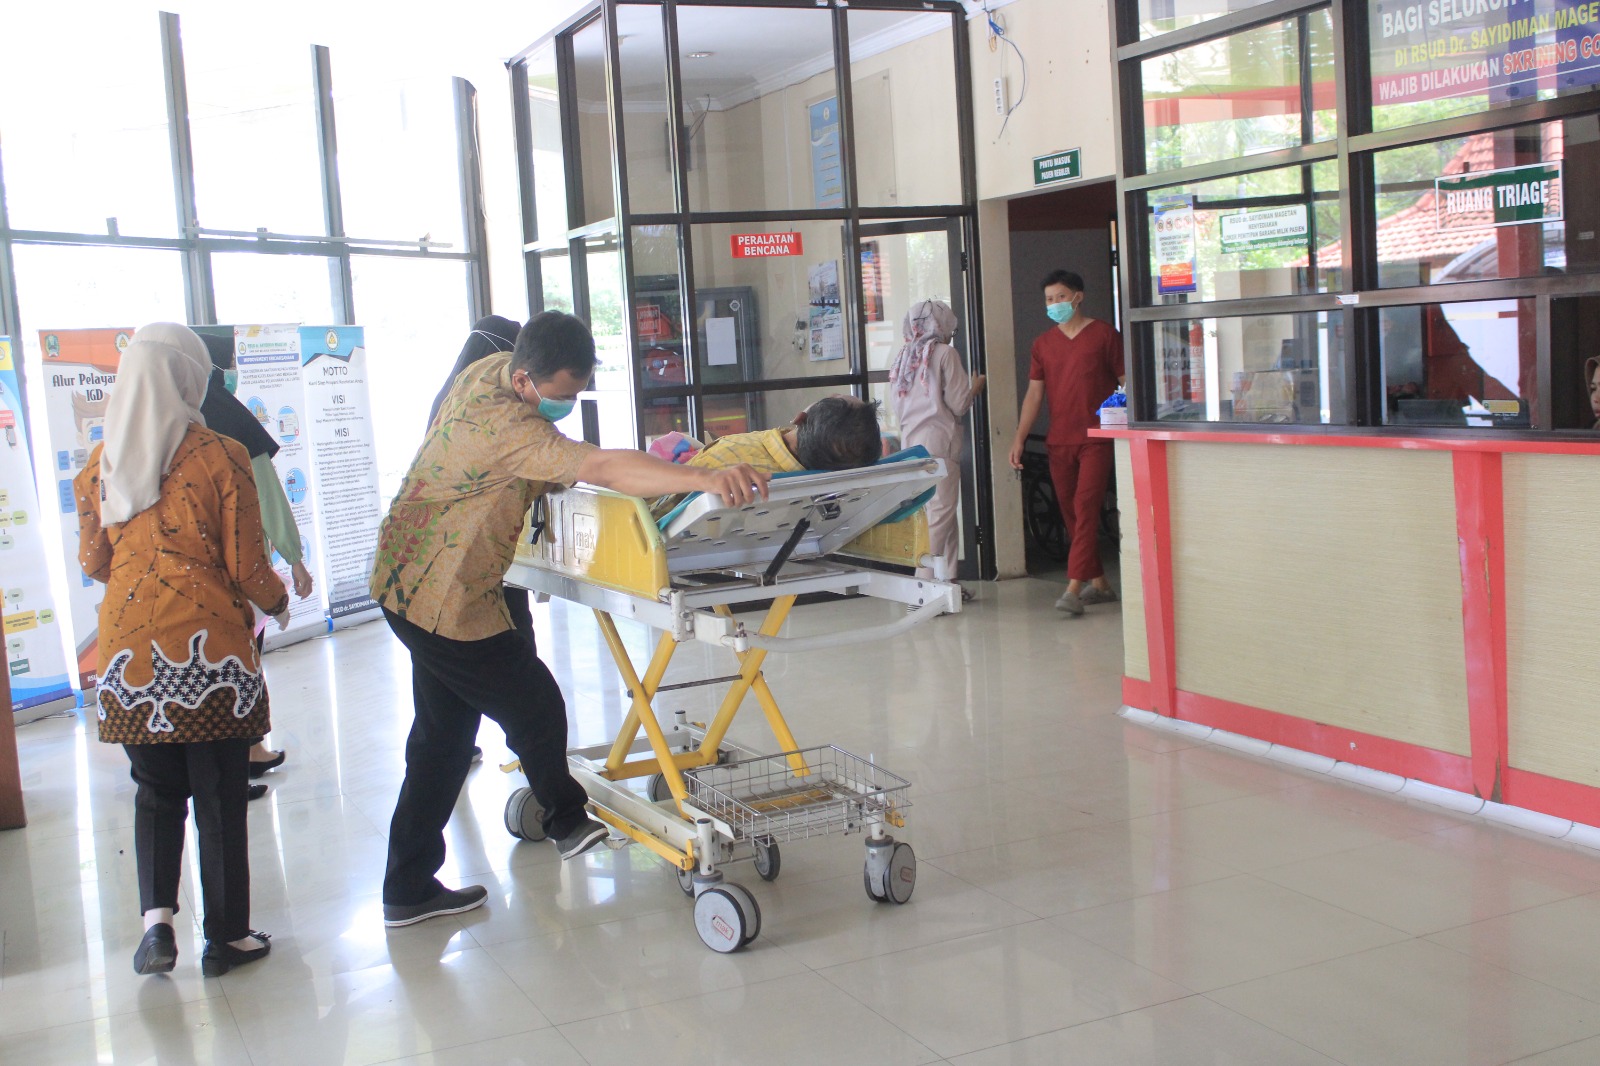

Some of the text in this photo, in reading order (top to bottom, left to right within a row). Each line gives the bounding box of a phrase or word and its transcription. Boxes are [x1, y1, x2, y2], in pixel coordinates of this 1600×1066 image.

[1382, 4, 1424, 38] BAGI
[1395, 47, 1408, 68] DI
[1411, 38, 1447, 64] RSUD
[1450, 35, 1468, 55] Dr.
[1471, 13, 1550, 50] SAYIDIMAN
[1379, 75, 1418, 100] WAJIB
[1421, 57, 1500, 92] DILAKUKAN
[1503, 39, 1577, 76] SKRINING
[1040, 156, 1070, 169] PINTU MASUK
[1447, 180, 1549, 215] RUANG TRIAGE
[1274, 210, 1297, 218] MAGETAN
[738, 234, 794, 245] PERALATAN
[744, 245, 790, 256] BENCANA
[322, 366, 348, 376] MOTTO
[52, 374, 76, 387] Alur
[86, 388, 104, 401] IGD
[332, 394, 346, 404] VISI
[335, 428, 350, 438] MISI
